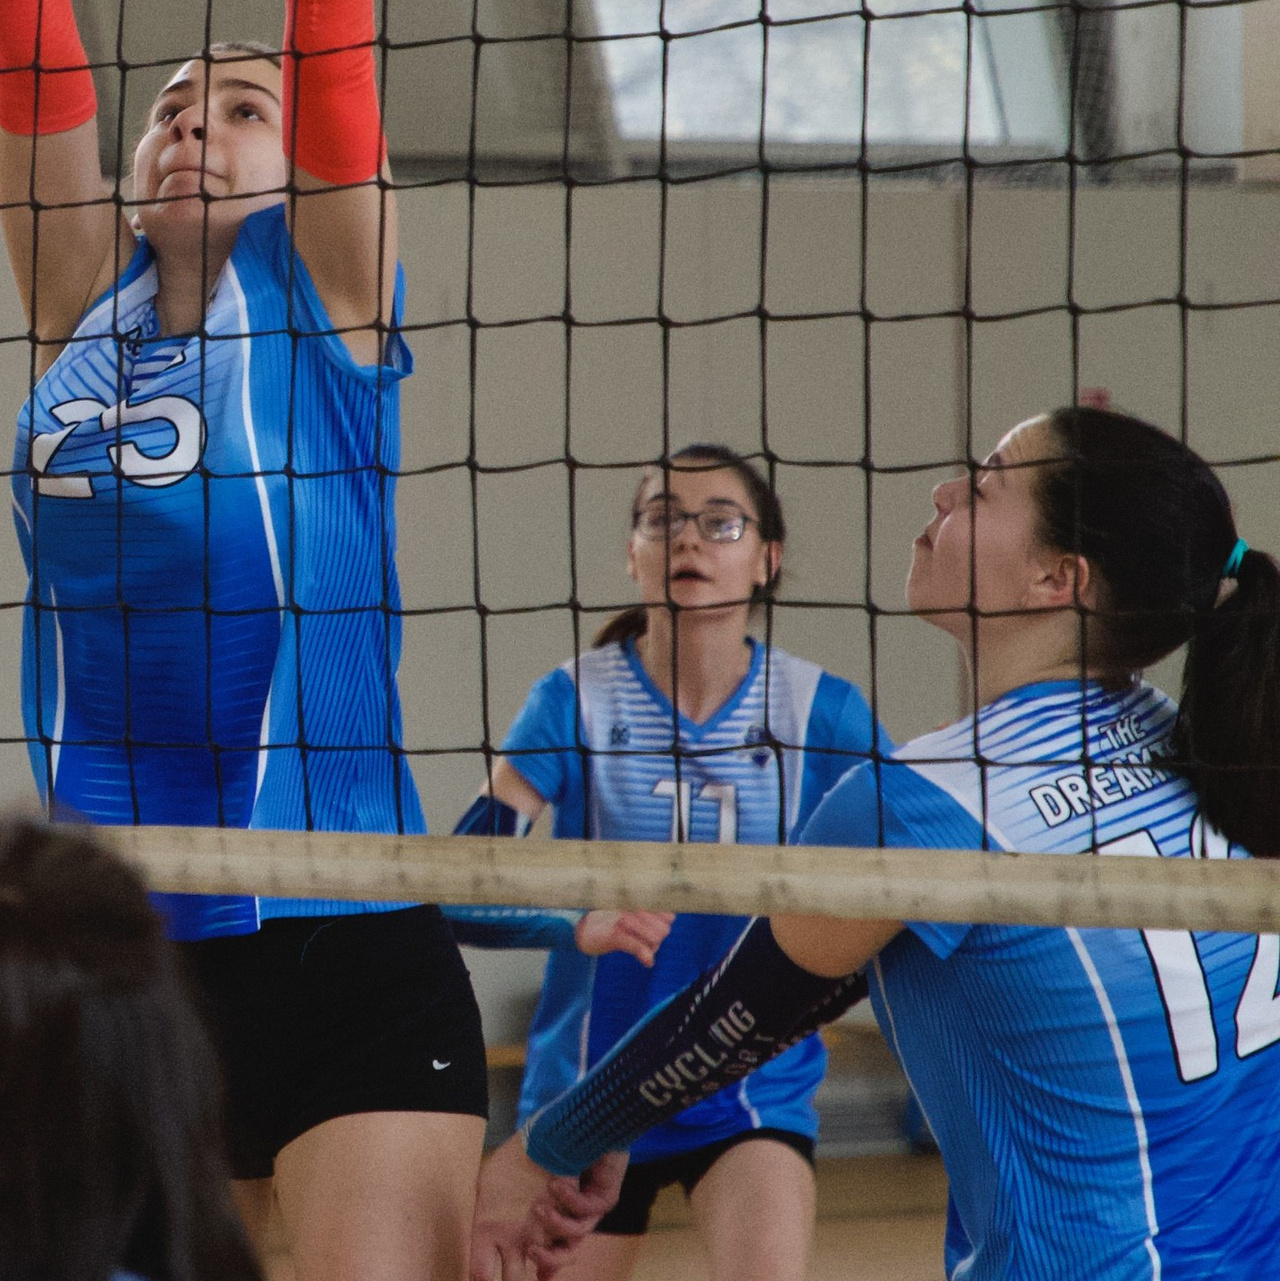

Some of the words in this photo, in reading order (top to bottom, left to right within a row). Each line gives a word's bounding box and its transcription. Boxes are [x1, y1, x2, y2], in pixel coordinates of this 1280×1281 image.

[32, 394, 208, 499] 25
[1098, 714, 1147, 750] THE
[651, 778, 739, 844] 11
[639, 999, 756, 1107] CYCLNG
